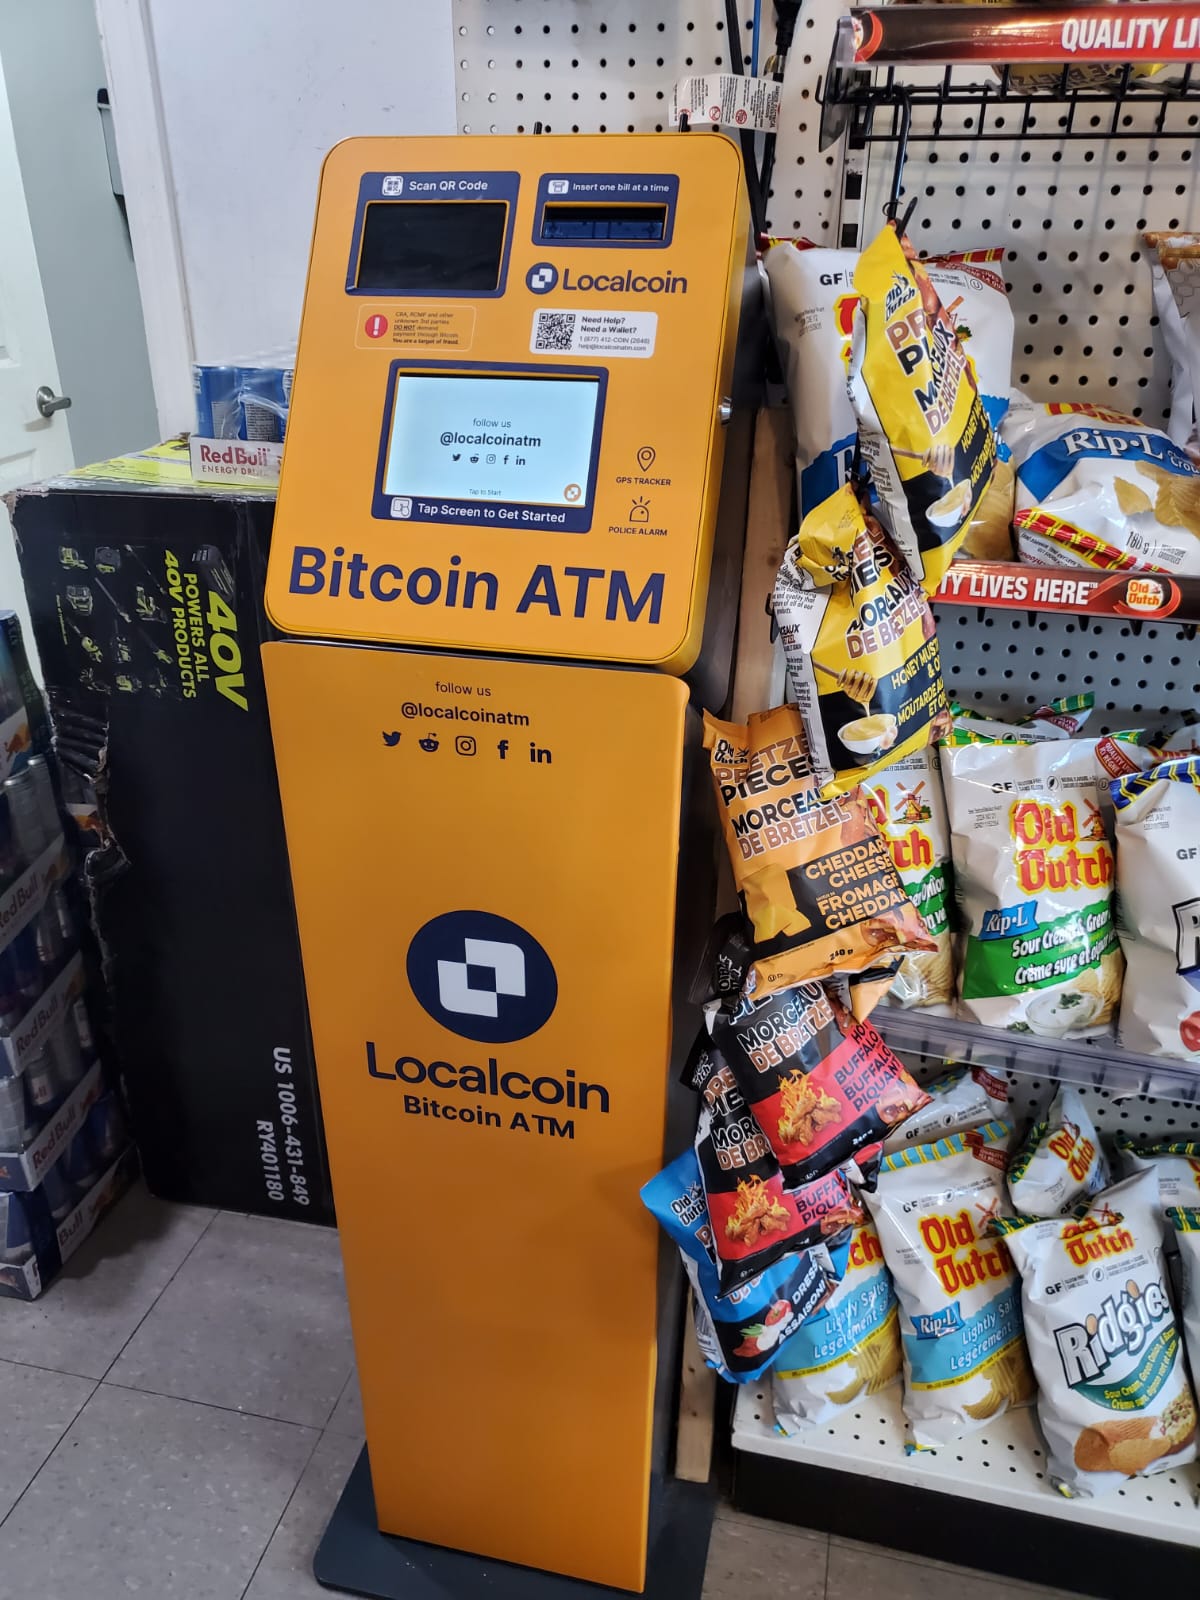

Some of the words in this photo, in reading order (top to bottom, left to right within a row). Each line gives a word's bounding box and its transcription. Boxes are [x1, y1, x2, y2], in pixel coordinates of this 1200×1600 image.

[1061, 17, 1169, 52] QUALITY
[409, 181, 437, 191] Scan
[439, 180, 456, 192] QR
[458, 180, 488, 191] Code
[573, 183, 598, 191] Insert
[617, 183, 630, 191] bill
[650, 184, 669, 192] time
[562, 268, 688, 294] Localcoin
[819, 272, 843, 286] GF
[603, 317, 626, 325] Help?
[609, 326, 637, 334] Wallet?
[473, 418, 498, 428] follow
[500, 420, 511, 428] us
[440, 432, 541, 447] @localcoinatm
[202, 465, 238, 475] ENERGY
[616, 476, 632, 484] GPS
[634, 477, 671, 486] TRACKER
[418, 503, 438, 516] Tap
[440, 504, 480, 518] Screen
[483, 507, 495, 518] to
[498, 508, 519, 520] Get
[522, 510, 565, 523] Started
[608, 526, 637, 535] POLICE
[638, 527, 668, 536] ALARM
[164, 549, 183, 605] 40V
[288, 545, 499, 612] Bitcoin
[515, 564, 665, 625] ATM
[969, 573, 1028, 600] LIVES
[1129, 579, 1150, 593] Old
[184, 572, 206, 655] POWERS
[1128, 592, 1160, 606] Dutch
[172, 606, 197, 699] PRODUCTS
[206, 590, 249, 712] 40V
[845, 626, 878, 660] DE
[194, 658, 211, 683] ALL
[891, 656, 920, 690] HONEY
[435, 681, 473, 698] follow
[476, 686, 491, 697] us
[897, 682, 936, 726] MOUTARDE
[401, 701, 530, 727] @localcoinatm
[991, 782, 1013, 793] GF
[764, 801, 851, 850] BRETZEL
[1013, 801, 1077, 846] Old
[738, 832, 766, 861] DE
[805, 836, 886, 881] CHEDDAR
[1176, 848, 1197, 860] GF
[828, 854, 892, 888] CHEESE
[1019, 846, 1113, 891] Dutch
[825, 888, 908, 930] CHEDDAR
[1012, 937, 1041, 958] Sour
[1014, 962, 1053, 985] Crème
[1053, 953, 1078, 975] sure
[273, 1046, 292, 1075] US
[749, 1048, 782, 1073] DE
[833, 1030, 879, 1085] BUFFALO
[366, 1041, 610, 1113] Localcoin
[403, 1094, 502, 1128] Bitcoin
[510, 1111, 575, 1139] ATM
[277, 1081, 310, 1206] 1006-431-849
[905, 1127, 920, 1139] GF
[1048, 1127, 1076, 1161] Old
[256, 1119, 285, 1201] RY401180
[716, 1144, 746, 1171] DE
[1067, 1136, 1096, 1182] Dutch
[671, 1194, 691, 1215] Old
[920, 1211, 976, 1254] Old
[1065, 1228, 1135, 1267] Dutch
[1045, 1282, 1062, 1295] GF
[962, 1312, 997, 1345] Lightly
[950, 1322, 1012, 1371] Légèrement
